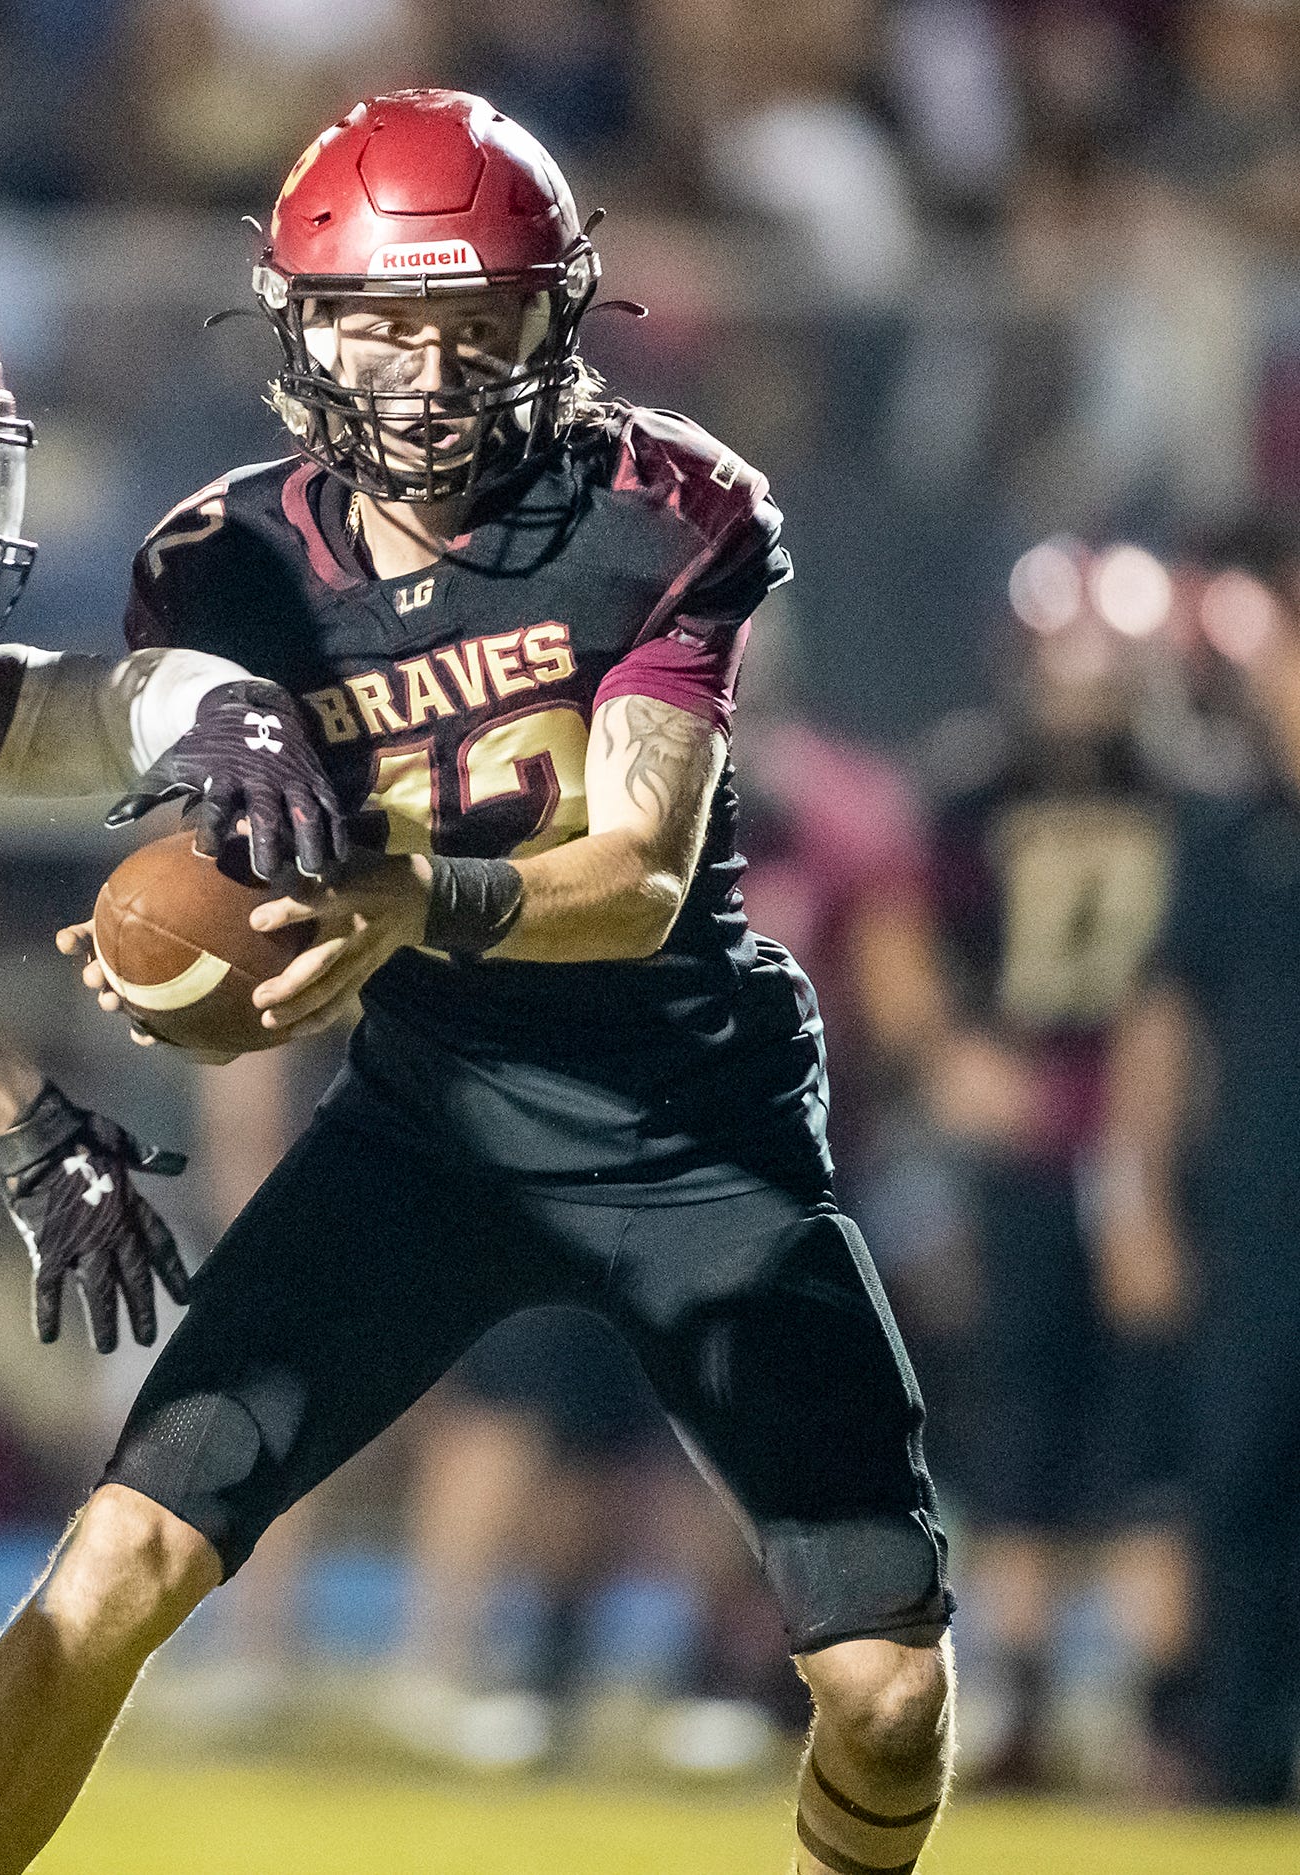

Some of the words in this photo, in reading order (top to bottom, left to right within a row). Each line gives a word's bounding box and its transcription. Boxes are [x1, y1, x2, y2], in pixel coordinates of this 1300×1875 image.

[382, 248, 467, 268] Riddell
[394, 577, 435, 614] LG
[301, 619, 577, 744] BRAVES
[357, 699, 590, 861] 12
